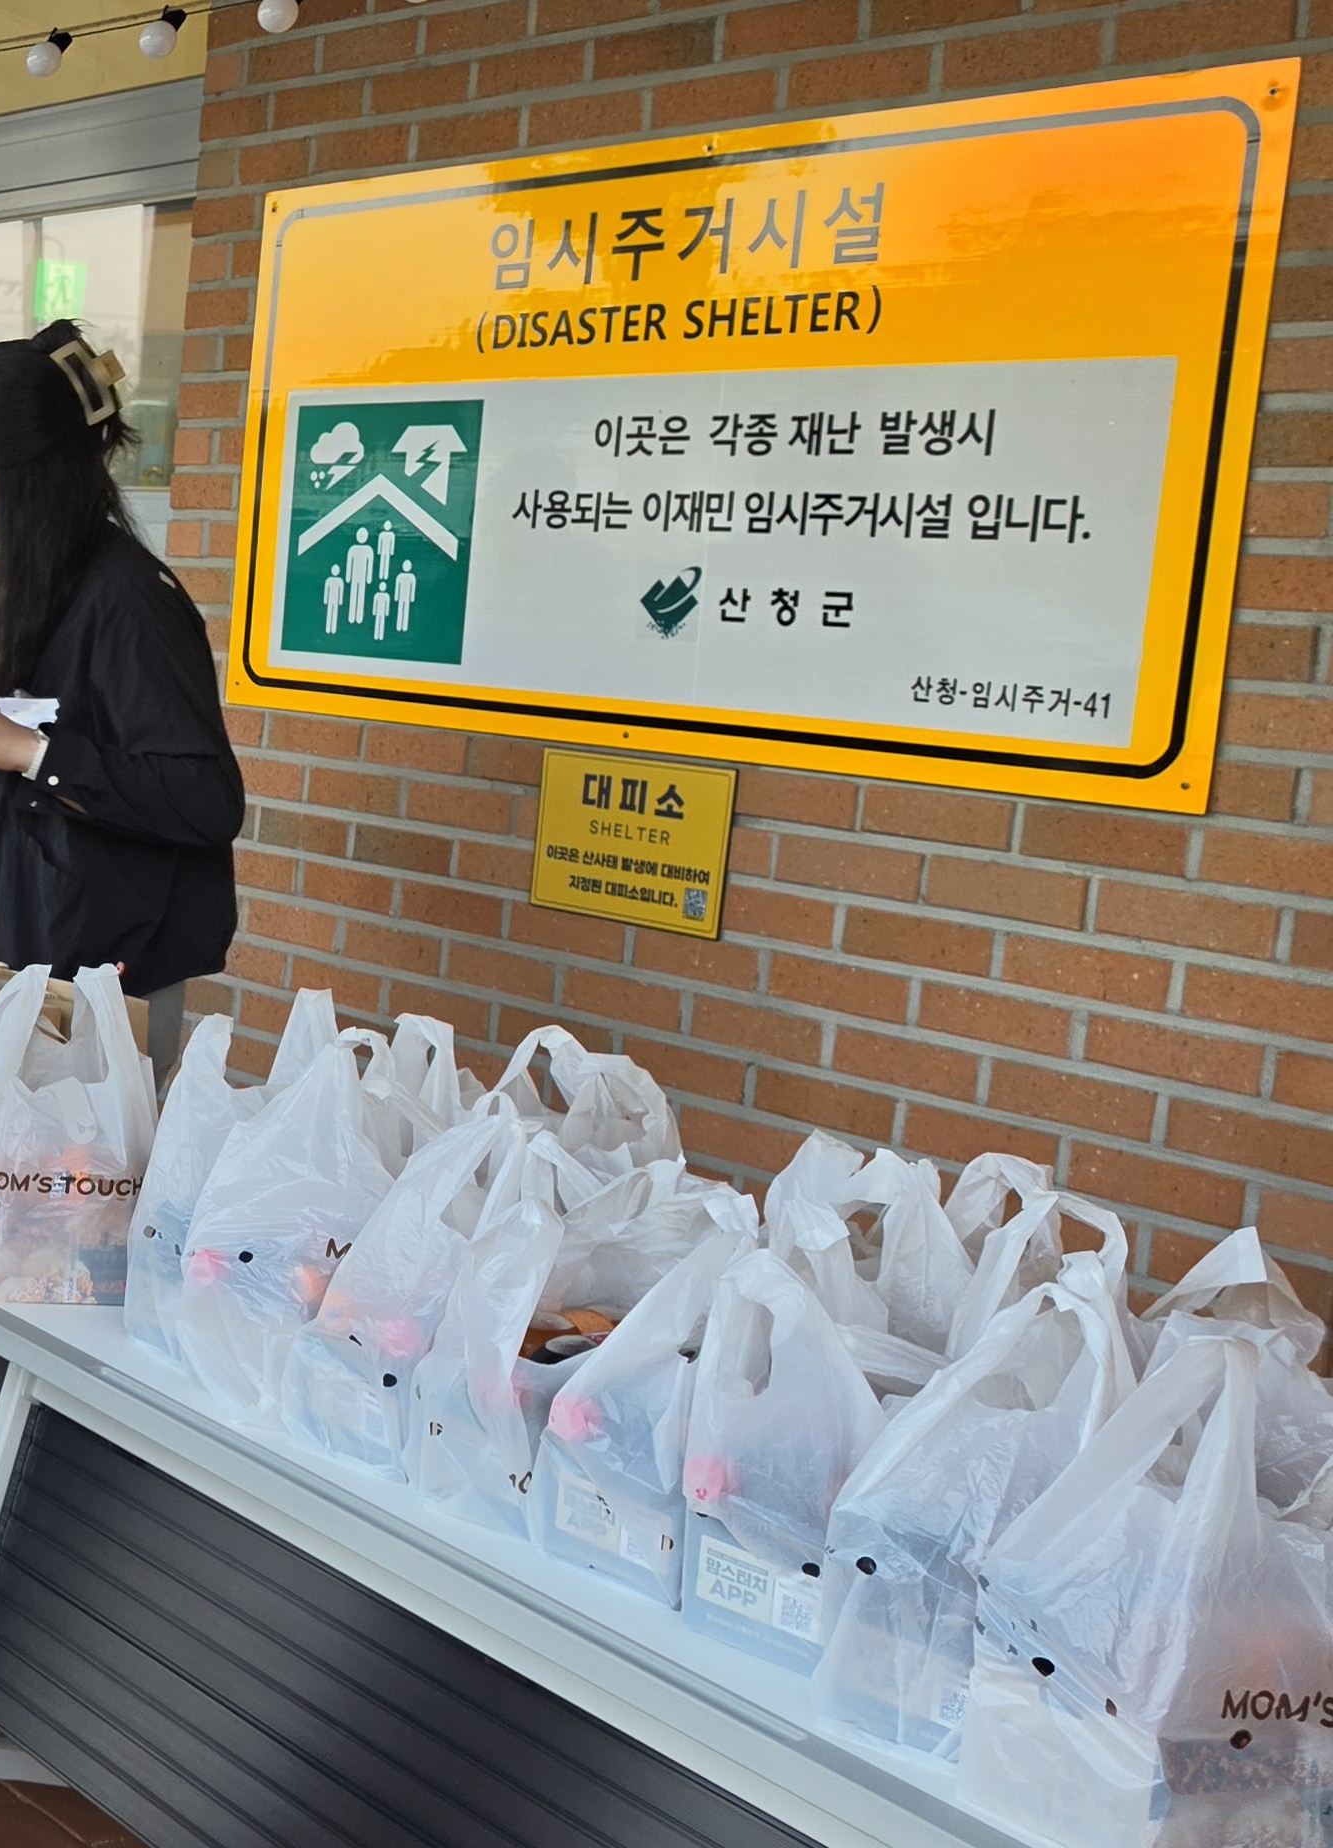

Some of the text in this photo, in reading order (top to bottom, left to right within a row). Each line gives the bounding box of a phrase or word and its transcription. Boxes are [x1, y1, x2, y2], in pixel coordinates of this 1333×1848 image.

[490, 182, 885, 291] 임시주거시설
[476, 284, 883, 355] (DISASTER SHELTER)
[594, 408, 997, 458] 이곳은 각종 재난 발생시
[511, 488, 1092, 544] 사용되는 이재민 임시주거시설 입니다.
[910, 674, 1112, 720] 산청-임시주거-41
[581, 773, 686, 820] 대피소
[588, 819, 671, 846] SHELTER
[546, 844, 711, 886] 이곳은 산사태 발생에 대비하여
[568, 874, 679, 908] 지정된 대피소입니다.
[59, 1174, 144, 1198] TOUCH
[705, 1557, 768, 1595] 맘스터치
[709, 1579, 759, 1608] APP
